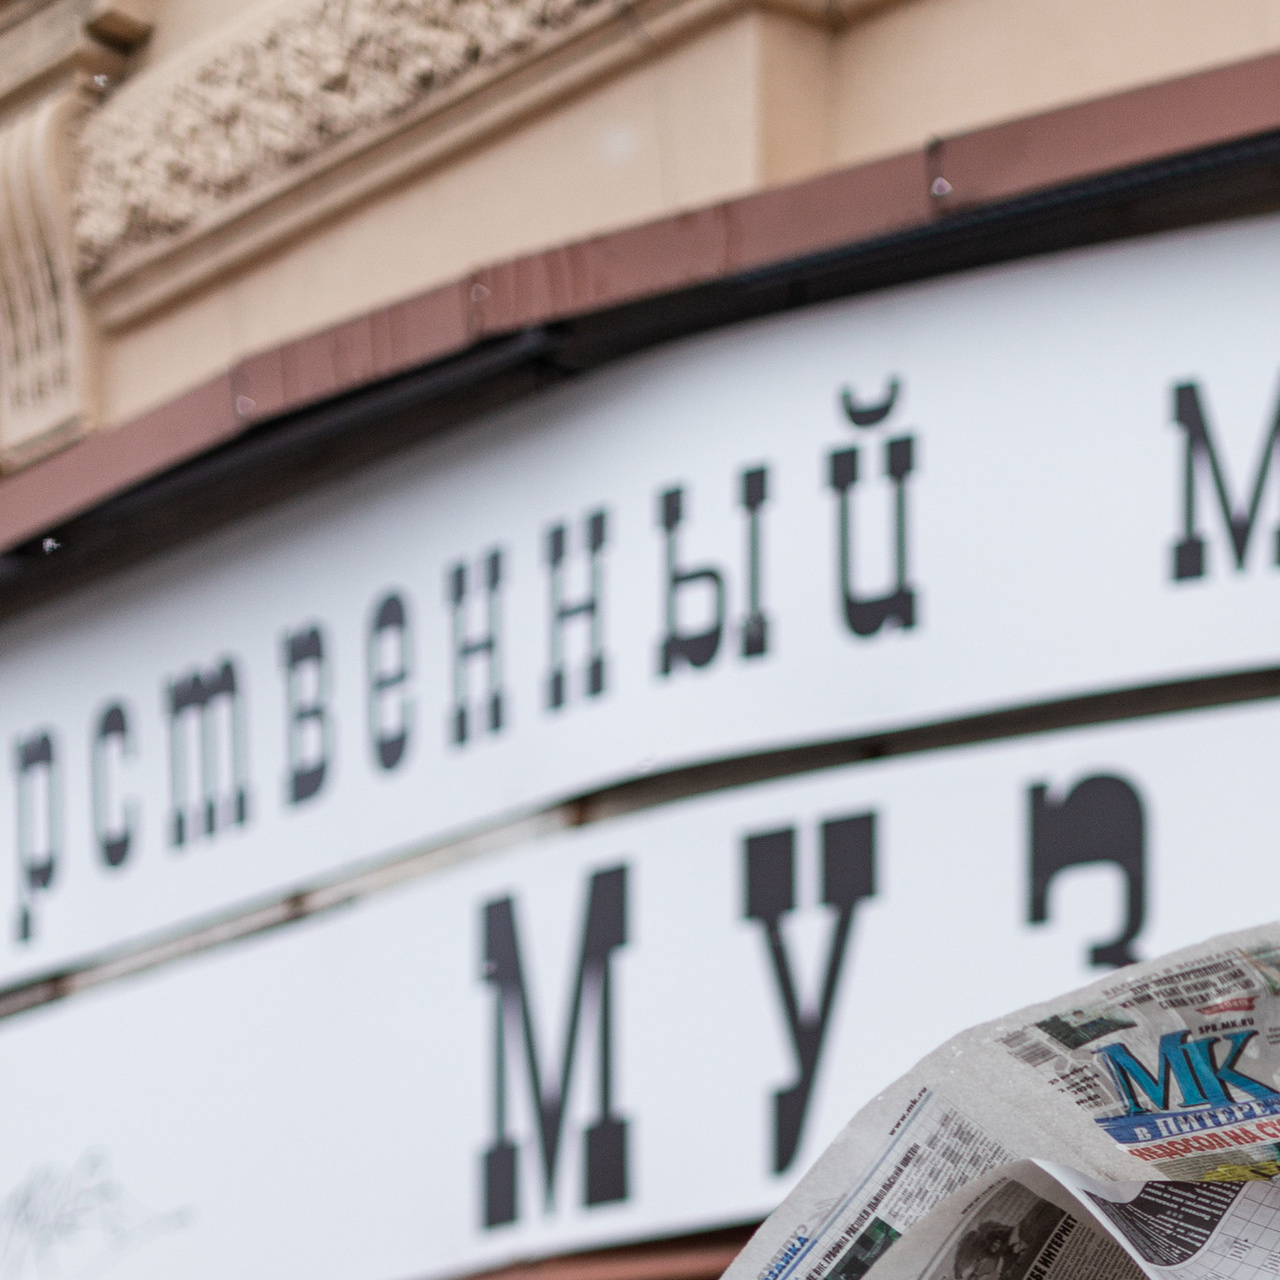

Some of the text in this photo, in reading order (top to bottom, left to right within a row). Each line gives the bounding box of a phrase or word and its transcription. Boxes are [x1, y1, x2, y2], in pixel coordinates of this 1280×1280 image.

[13, 376, 920, 943] рственный
[1198, 1013, 1255, 1037] SPB.MK.RU
[887, 1084, 928, 1137] www.mk.ru
[1154, 1098, 1271, 1137] ПИТЕРЕ
[1127, 1130, 1229, 1162] НЕДОСОЛ
[1227, 1123, 1262, 1146] НА
[844, 1207, 871, 1238] РАСЦВЕЛ
[1037, 1213, 1079, 1269] ИНТЕРНЕТ
